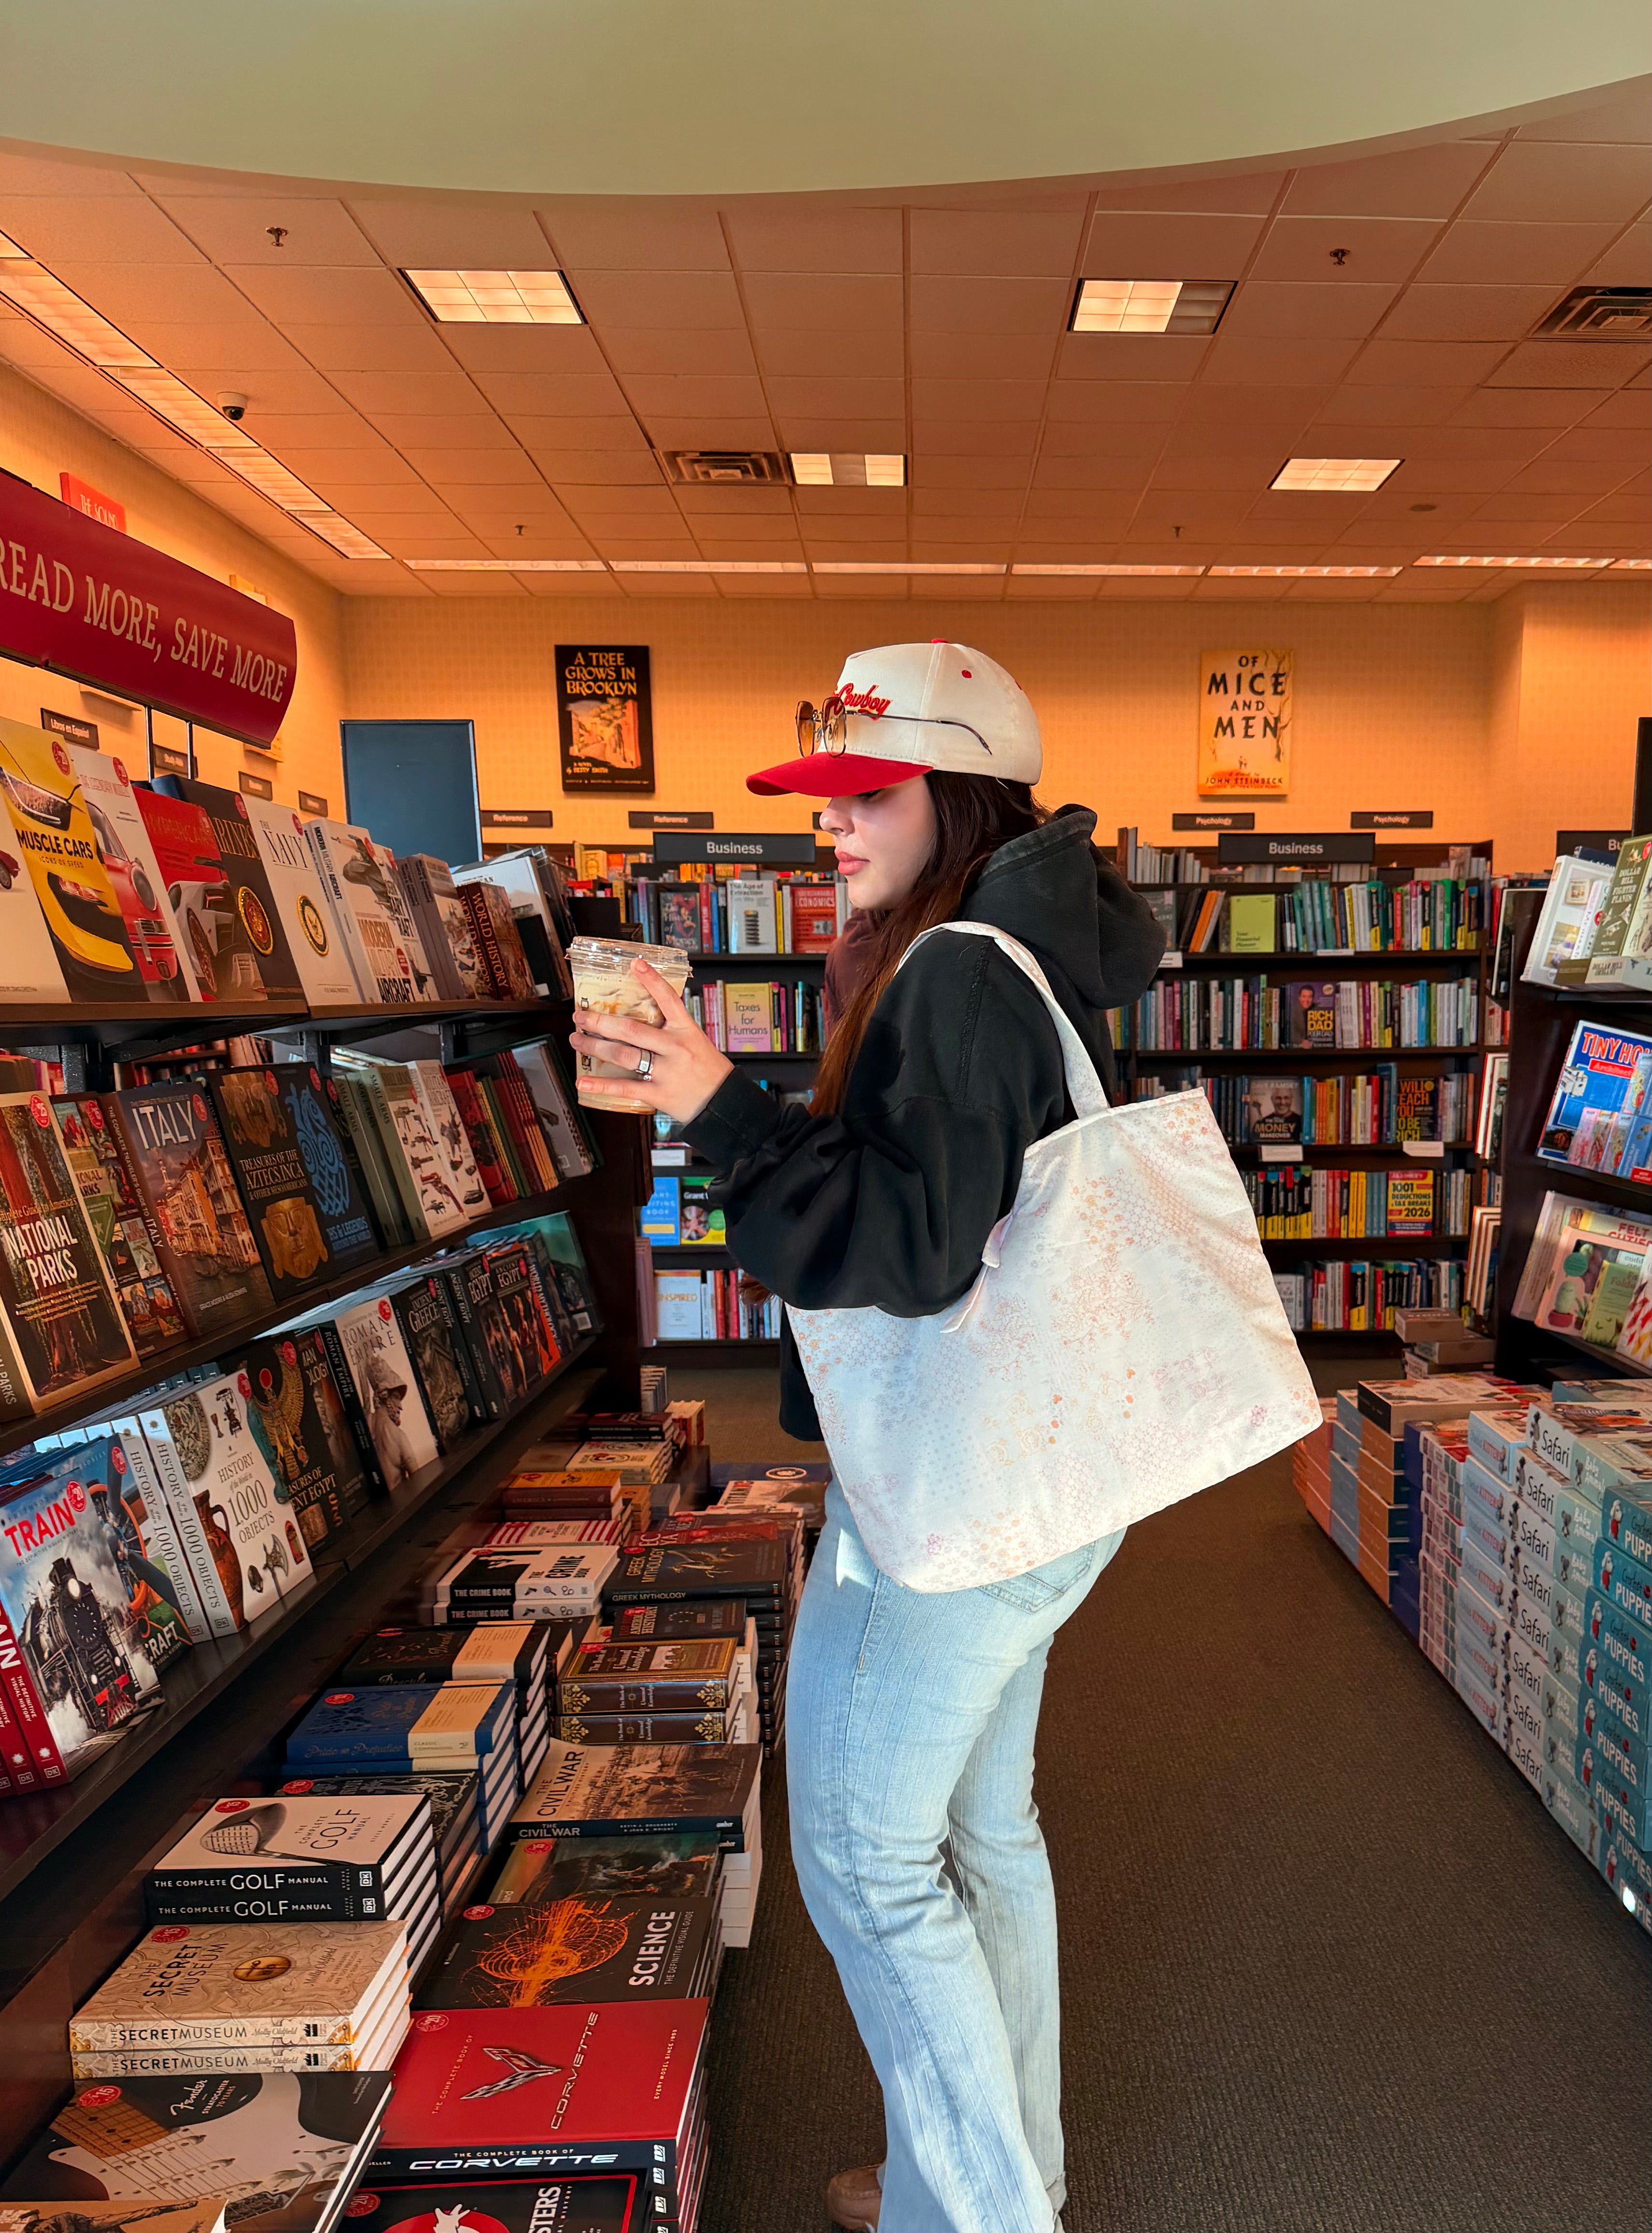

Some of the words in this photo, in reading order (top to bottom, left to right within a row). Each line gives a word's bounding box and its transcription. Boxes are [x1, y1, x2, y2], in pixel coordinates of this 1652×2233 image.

[84, 575, 162, 663] MORE,
[170, 618, 228, 678] SAVE
[230, 644, 287, 703] MORE
[565, 667, 616, 680] GROWS
[621, 667, 635, 680] IN
[574, 652, 585, 665] A
[589, 653, 625, 665] TREE
[1238, 656, 1258, 667] OF
[566, 681, 636, 696] BROOKLYN
[826, 683, 891, 715] Cowboy
[1208, 673, 1286, 695] MICE
[1230, 701, 1264, 711] AND
[1214, 716, 1280, 738] MEN
[1196, 817, 1232, 827] Psychology
[1373, 815, 1410, 825] Psychology
[15, 829, 63, 855] MUSCLE
[64, 837, 94, 860] CARS
[263, 830, 309, 868] NAVY
[707, 842, 763, 854] Business
[1269, 842, 1323, 854] Business
[357, 919, 395, 949] MODERN
[460, 896, 477, 943] WORLD
[472, 893, 493, 937] WORLD
[485, 940, 508, 988] HISTORY
[376, 977, 416, 1003] AIRCRAFT
[733, 1002, 760, 1012] Taxes
[741, 1014, 754, 1025] for
[1307, 1009, 1334, 1021] RICH
[729, 1026, 768, 1035] Humans
[1307, 1021, 1333, 1031] DAD
[1581, 1032, 1622, 1060] TINY
[370, 1074, 383, 1099] SMALL
[378, 1103, 390, 1124] ARMS
[1401, 1081, 1425, 1093] WILL
[132, 1101, 197, 1149] ITALY
[1256, 1124, 1296, 1133] MONEY
[239, 1154, 276, 1172] TREASURES
[276, 1152, 285, 1165] OF
[285, 1149, 298, 1161] THE
[1392, 1183, 1414, 1192] 1001
[135, 1188, 147, 1207] GUIDE
[145, 1218, 164, 1247] ITALY
[1404, 1208, 1430, 1217] 2026
[3, 1215, 78, 1260] NATIONAL
[1618, 1222, 1650, 1237] FELT
[26, 1249, 78, 1290] PARKS
[497, 1268, 521, 1287] EGYPT
[467, 1273, 493, 1303] EGYPT
[342, 1315, 389, 1347] ROMAN
[408, 1302, 440, 1333] GREECE
[348, 1330, 396, 1366] EMPIRE
[324, 1331, 339, 1365] ROMAN
[336, 1364, 351, 1399] EMPIRE
[0, 1371, 17, 1405] PARKS
[1541, 1430, 1569, 1469] Safari
[217, 1452, 255, 1484] HISTORY
[309, 1473, 337, 1502] EGYPT
[1527, 1476, 1554, 1515] Safari
[227, 1479, 268, 1527] 1,000
[4, 1498, 75, 1557] TRAIN
[130, 1451, 157, 1506] HISTORY
[169, 1564, 195, 1616] OBJECTS
[156, 1443, 184, 1499] HISTORY
[196, 1557, 221, 1608] OBJECTS
[239, 1511, 275, 1543] OBJECTS
[1521, 1521, 1550, 1561] Safari
[626, 1556, 646, 1576] GREEK
[641, 1548, 665, 1583] MYTHOLOGY
[639, 1592, 686, 1600] MYTHOLOGY
[1522, 1565, 1551, 1607] Safari
[1615, 1582, 1652, 1626] PUPPIE
[1520, 1609, 1549, 1652] Safari
[1604, 1632, 1645, 1683] PUPPIES
[1512, 1652, 1540, 1696] Safari
[10, 1677, 21, 1696] VISUAL
[18, 1696, 32, 1722] HISTORY
[20, 1683, 38, 1718] DEFINITIVE
[1598, 1680, 1639, 1733] PUPPIES
[1513, 1695, 1540, 1739] Safari
[305, 1745, 337, 1758] Pride
[1514, 1740, 1543, 1785] Safari
[1597, 1730, 1637, 1785] PUPPIES
[20, 1774, 32, 1783] DK
[46, 1768, 59, 1777] DK
[553, 1752, 584, 1784] WAR
[537, 1779, 552, 1795] THE
[537, 1785, 570, 1816] CIVIL
[1595, 1781, 1636, 1837] PUPPIES
[294, 1824, 308, 1835] THE
[298, 1815, 329, 1845] COMPLETE
[310, 1809, 361, 1850] GOLF
[348, 1816, 371, 1840] MANUAL
[519, 1828, 552, 1837] CIVIL
[555, 1827, 580, 1836] WAR
[230, 1873, 285, 1890] GOLF
[361, 1872, 371, 1884] DK
[234, 1901, 289, 1917] GOLF
[365, 1900, 375, 1911] DK
[683, 1911, 694, 1926] GUIDE
[629, 1911, 676, 1986] SCIENCE
[677, 1927, 689, 1945] VISUAL
[140, 1962, 161, 1978] THE
[143, 1944, 203, 1997] SECRET
[171, 1942, 229, 1997] MUSEUM
[668, 1943, 684, 1973] DEFINITIVE
[664, 1973, 675, 1984] THE
[664, 2042, 675, 2059] SINCE
[432, 2100, 444, 2115] THE
[439, 2066, 459, 2099] COMPLETE
[453, 2045, 469, 2065] BOOK
[466, 2034, 475, 2044] OF
[550, 2011, 599, 2130] CORVETTE
[658, 2060, 671, 2079] MODEL
[170, 2078, 208, 2116] Fender
[202, 2079, 230, 2115] STRATOCASTER
[216, 2099, 226, 2108] 70
[223, 2085, 236, 2101] YEARS
[653, 2081, 664, 2100] EVERY
[409, 2153, 619, 2171] CORVETTE
